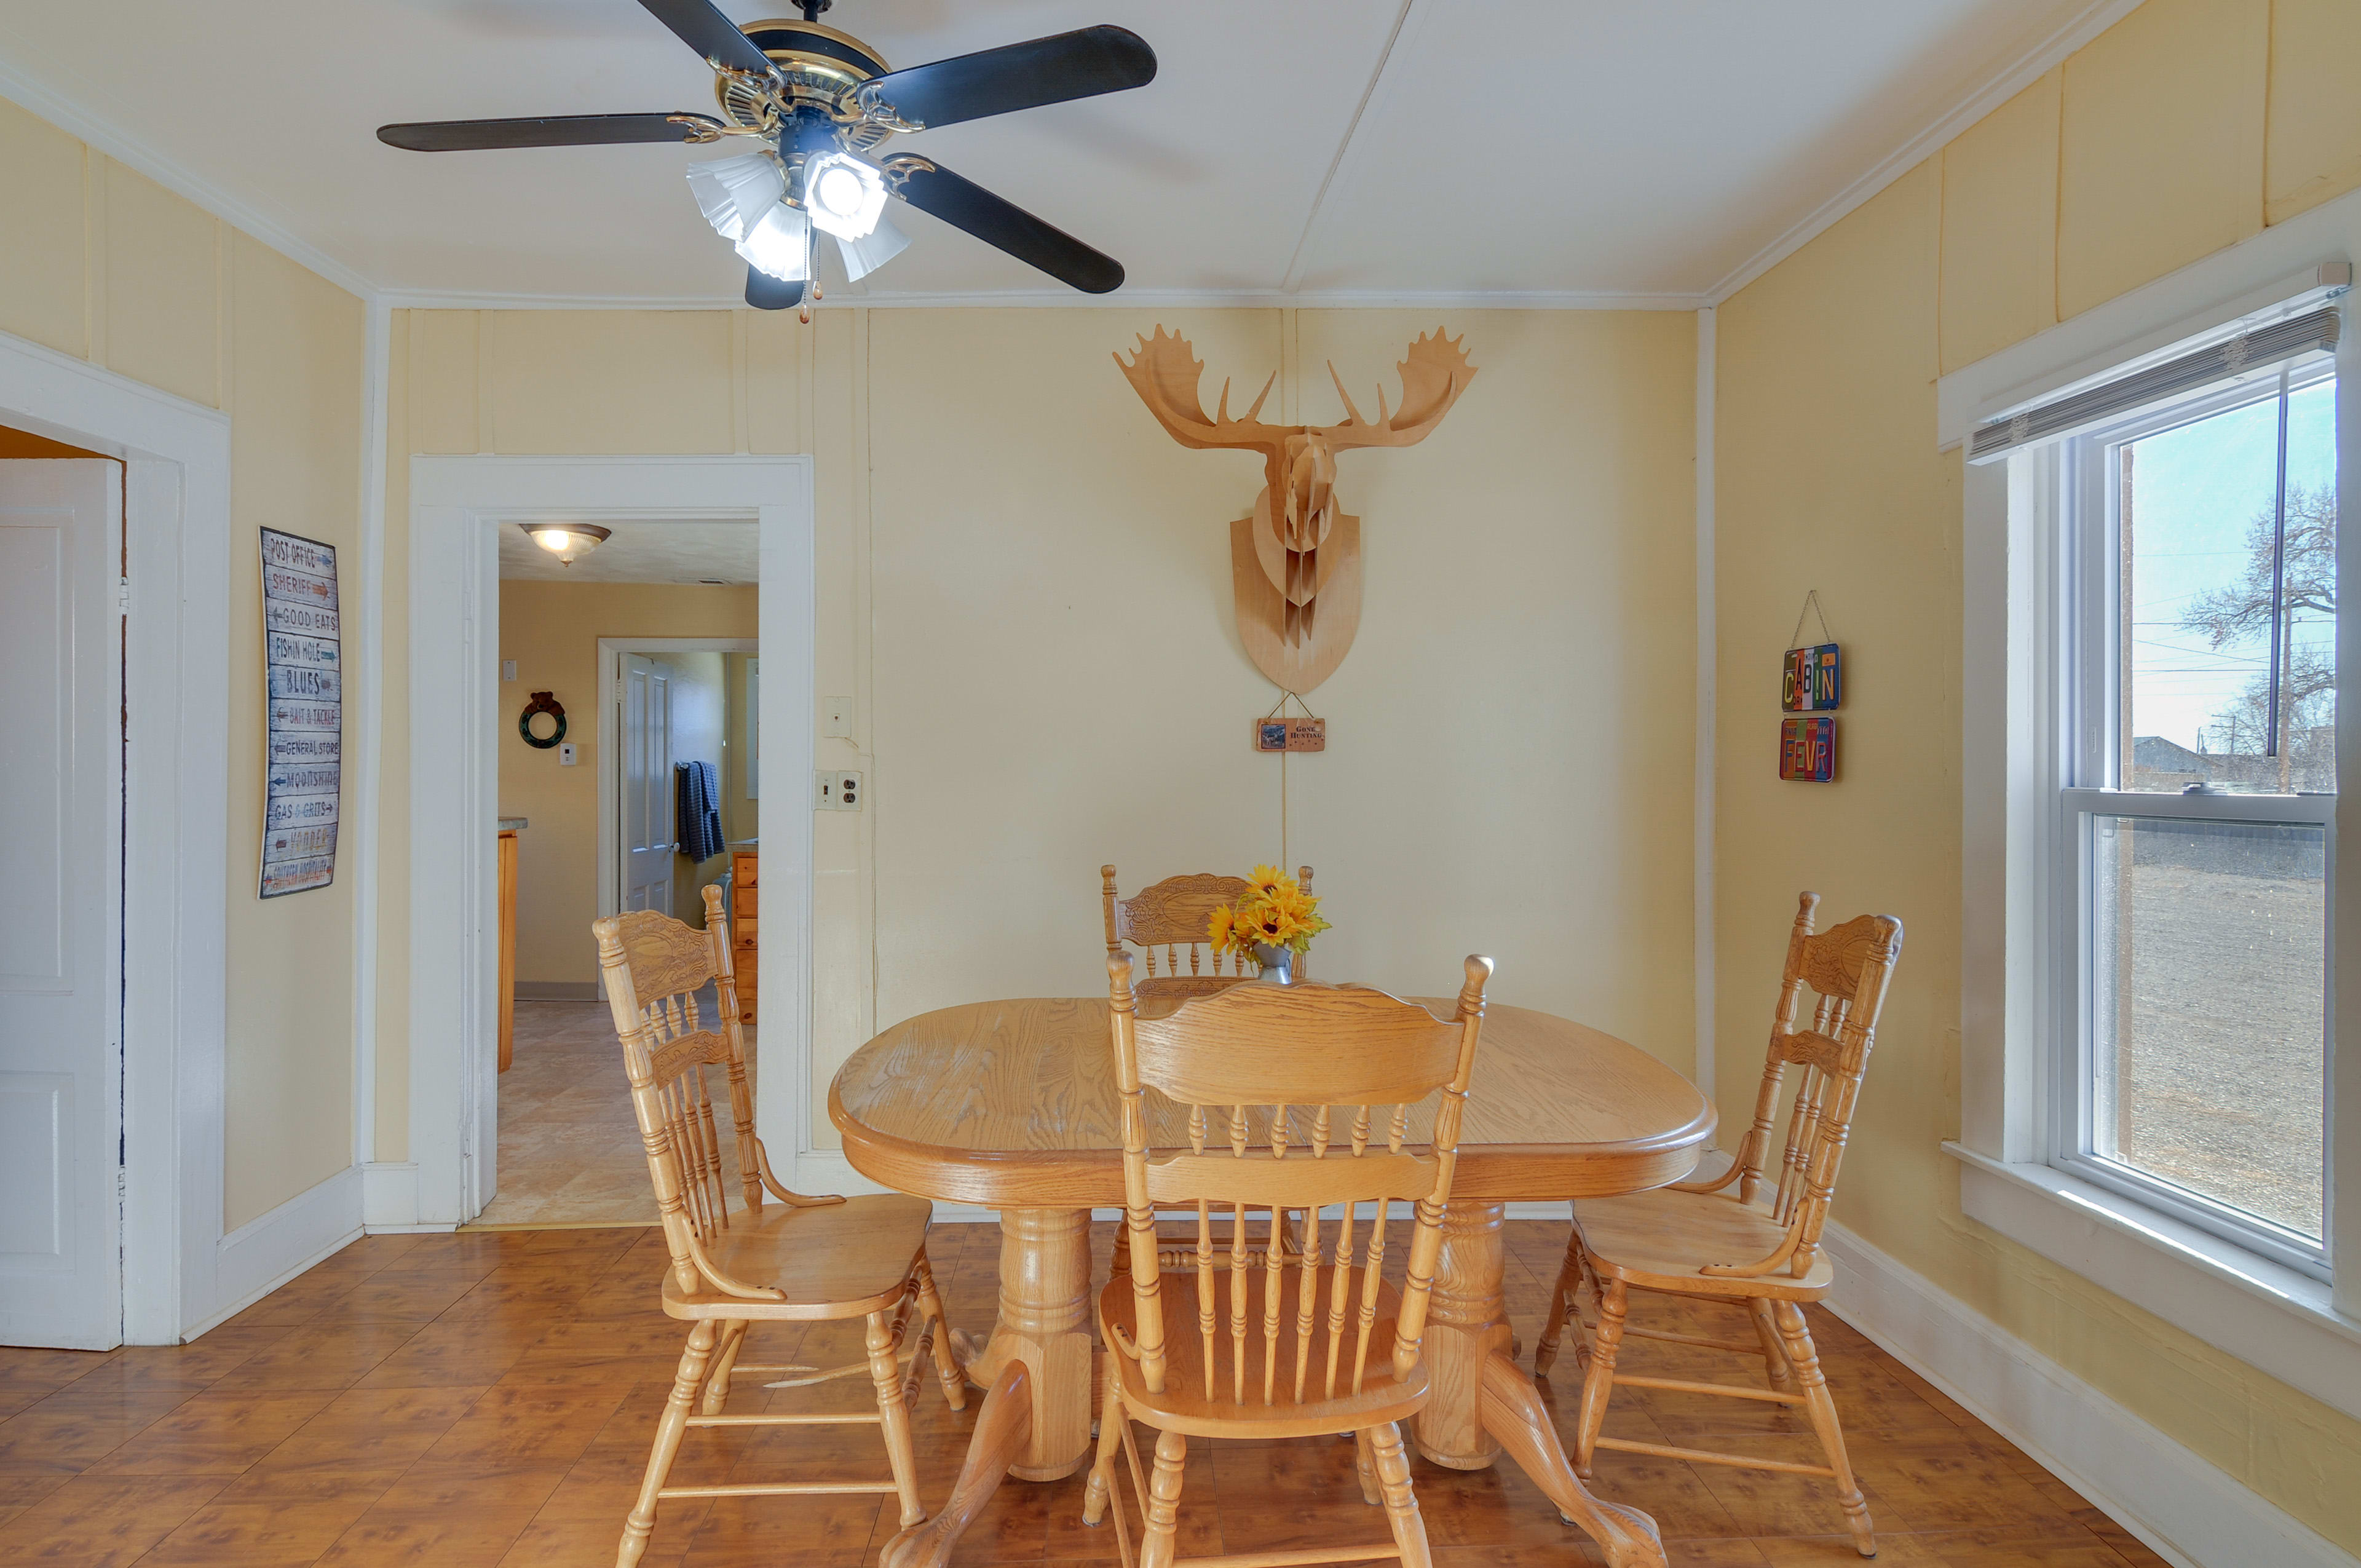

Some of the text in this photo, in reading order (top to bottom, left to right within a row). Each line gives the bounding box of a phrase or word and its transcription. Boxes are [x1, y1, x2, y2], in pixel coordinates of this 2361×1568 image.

[271, 538, 315, 568] POST OFFICE
[272, 573, 310, 595] SHERIFF
[283, 608, 336, 631] GOOD EATS
[276, 637, 320, 662] FISHIN HOLE
[287, 670, 320, 695] BLUES
[1785, 659, 1835, 703] CABIN
[290, 707, 305, 724] BAIT
[313, 709, 335, 725] TACKLE
[286, 739, 339, 756] GENERAL STORE
[1785, 739, 1827, 772] FEVR
[287, 771, 338, 788] MOONSHINE
[275, 804, 292, 821] GAS
[303, 802, 325, 817] GRITS
[290, 828, 328, 853] YONDER
